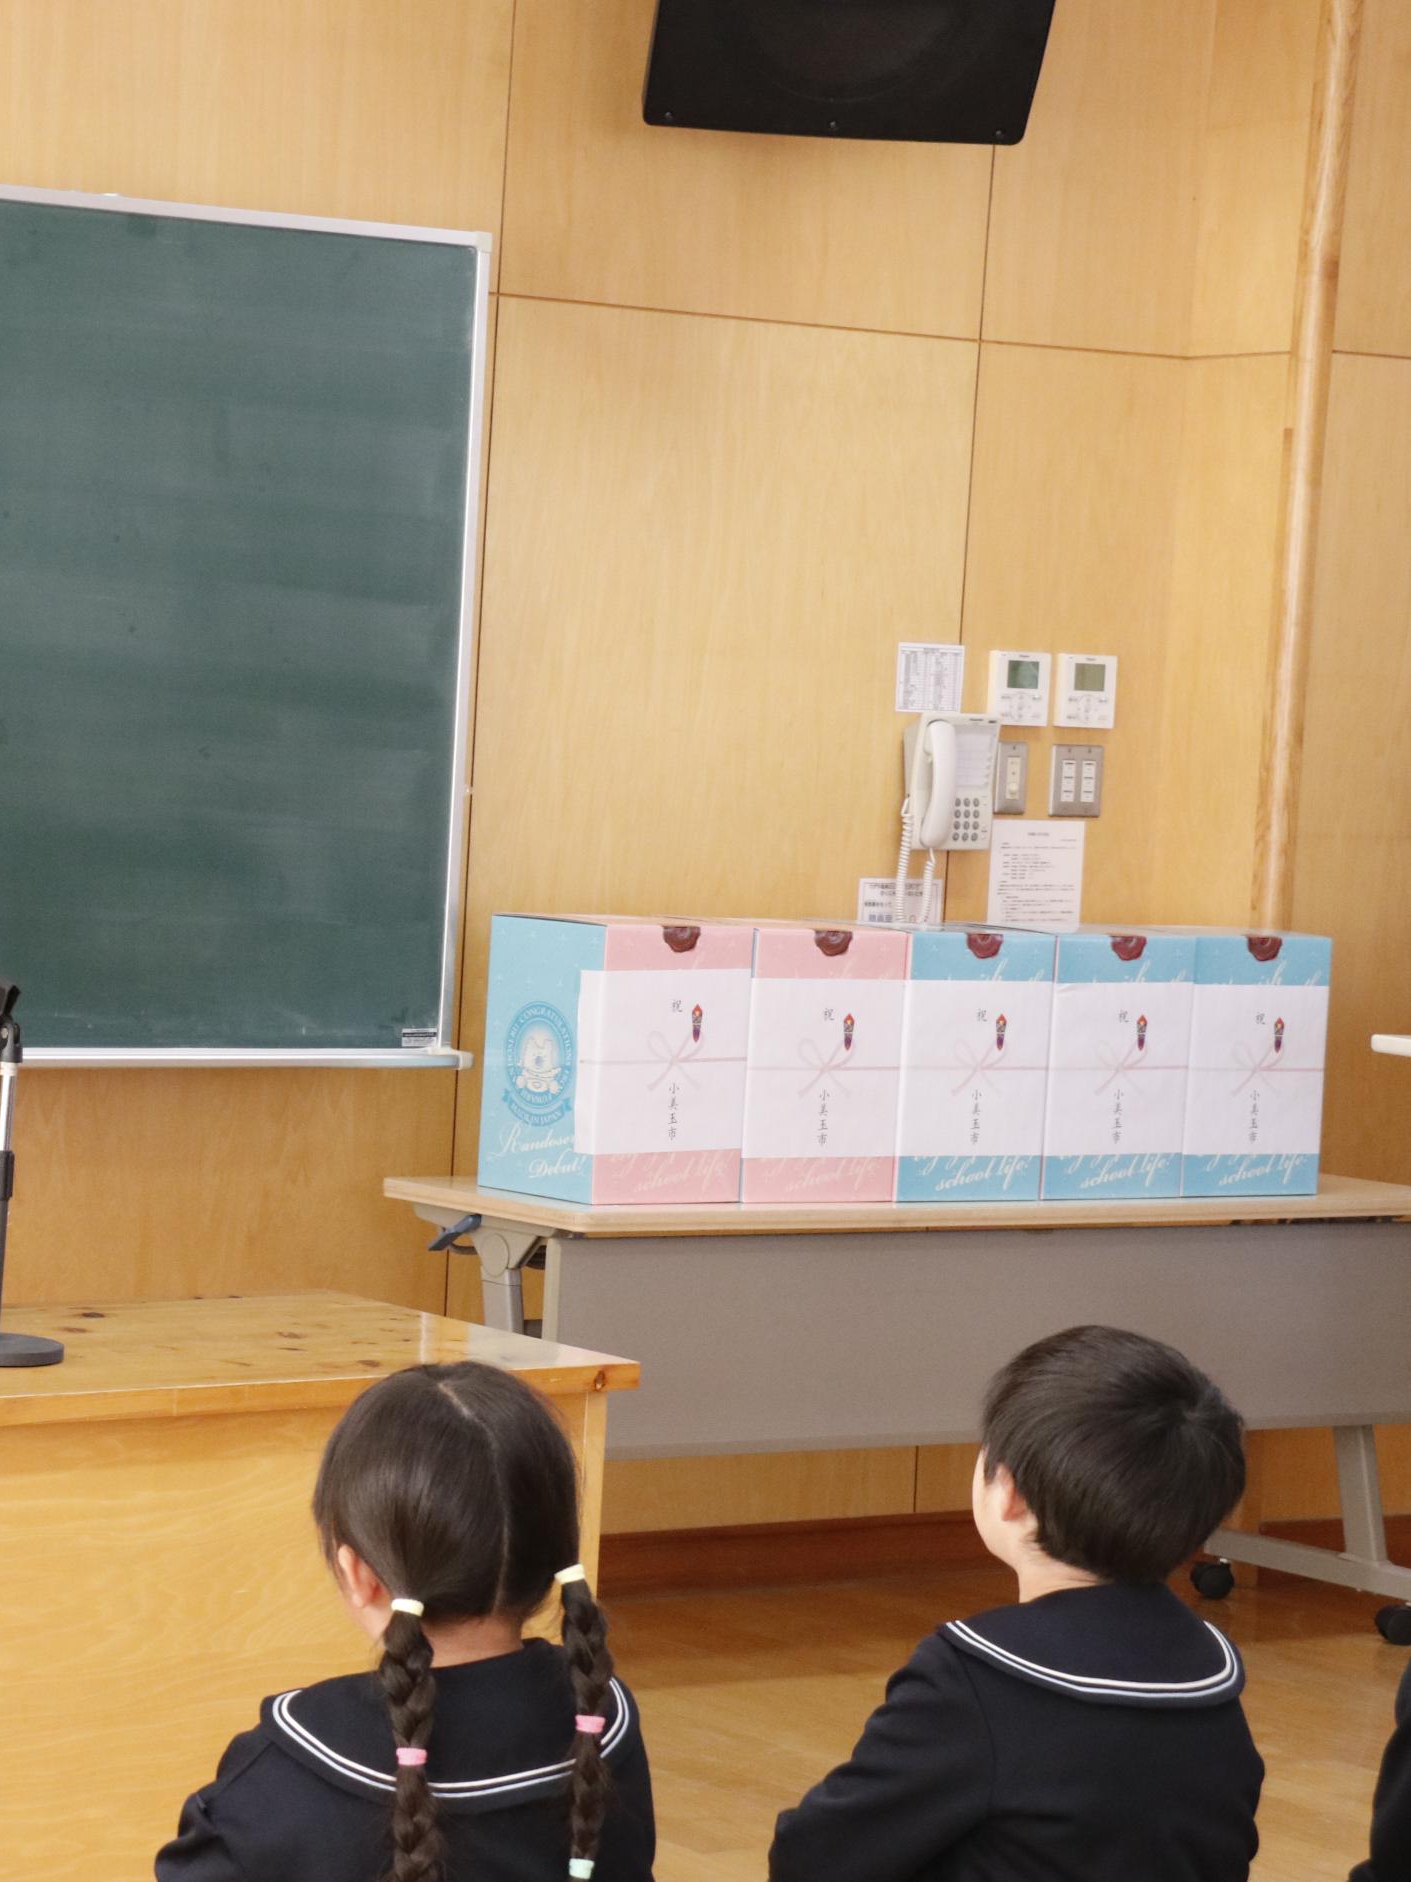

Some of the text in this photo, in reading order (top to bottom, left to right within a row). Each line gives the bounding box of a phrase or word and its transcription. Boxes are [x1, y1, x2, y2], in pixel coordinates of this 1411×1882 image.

[671, 999, 683, 1013] 祝
[823, 1008, 835, 1021] 祝
[667, 1082, 680, 1141] 小美玉市
[817, 1089, 830, 1146] 小美玉市
[935, 1157, 996, 1192] school
[1080, 1155, 1140, 1189] school
[1219, 1154, 1277, 1186] school
